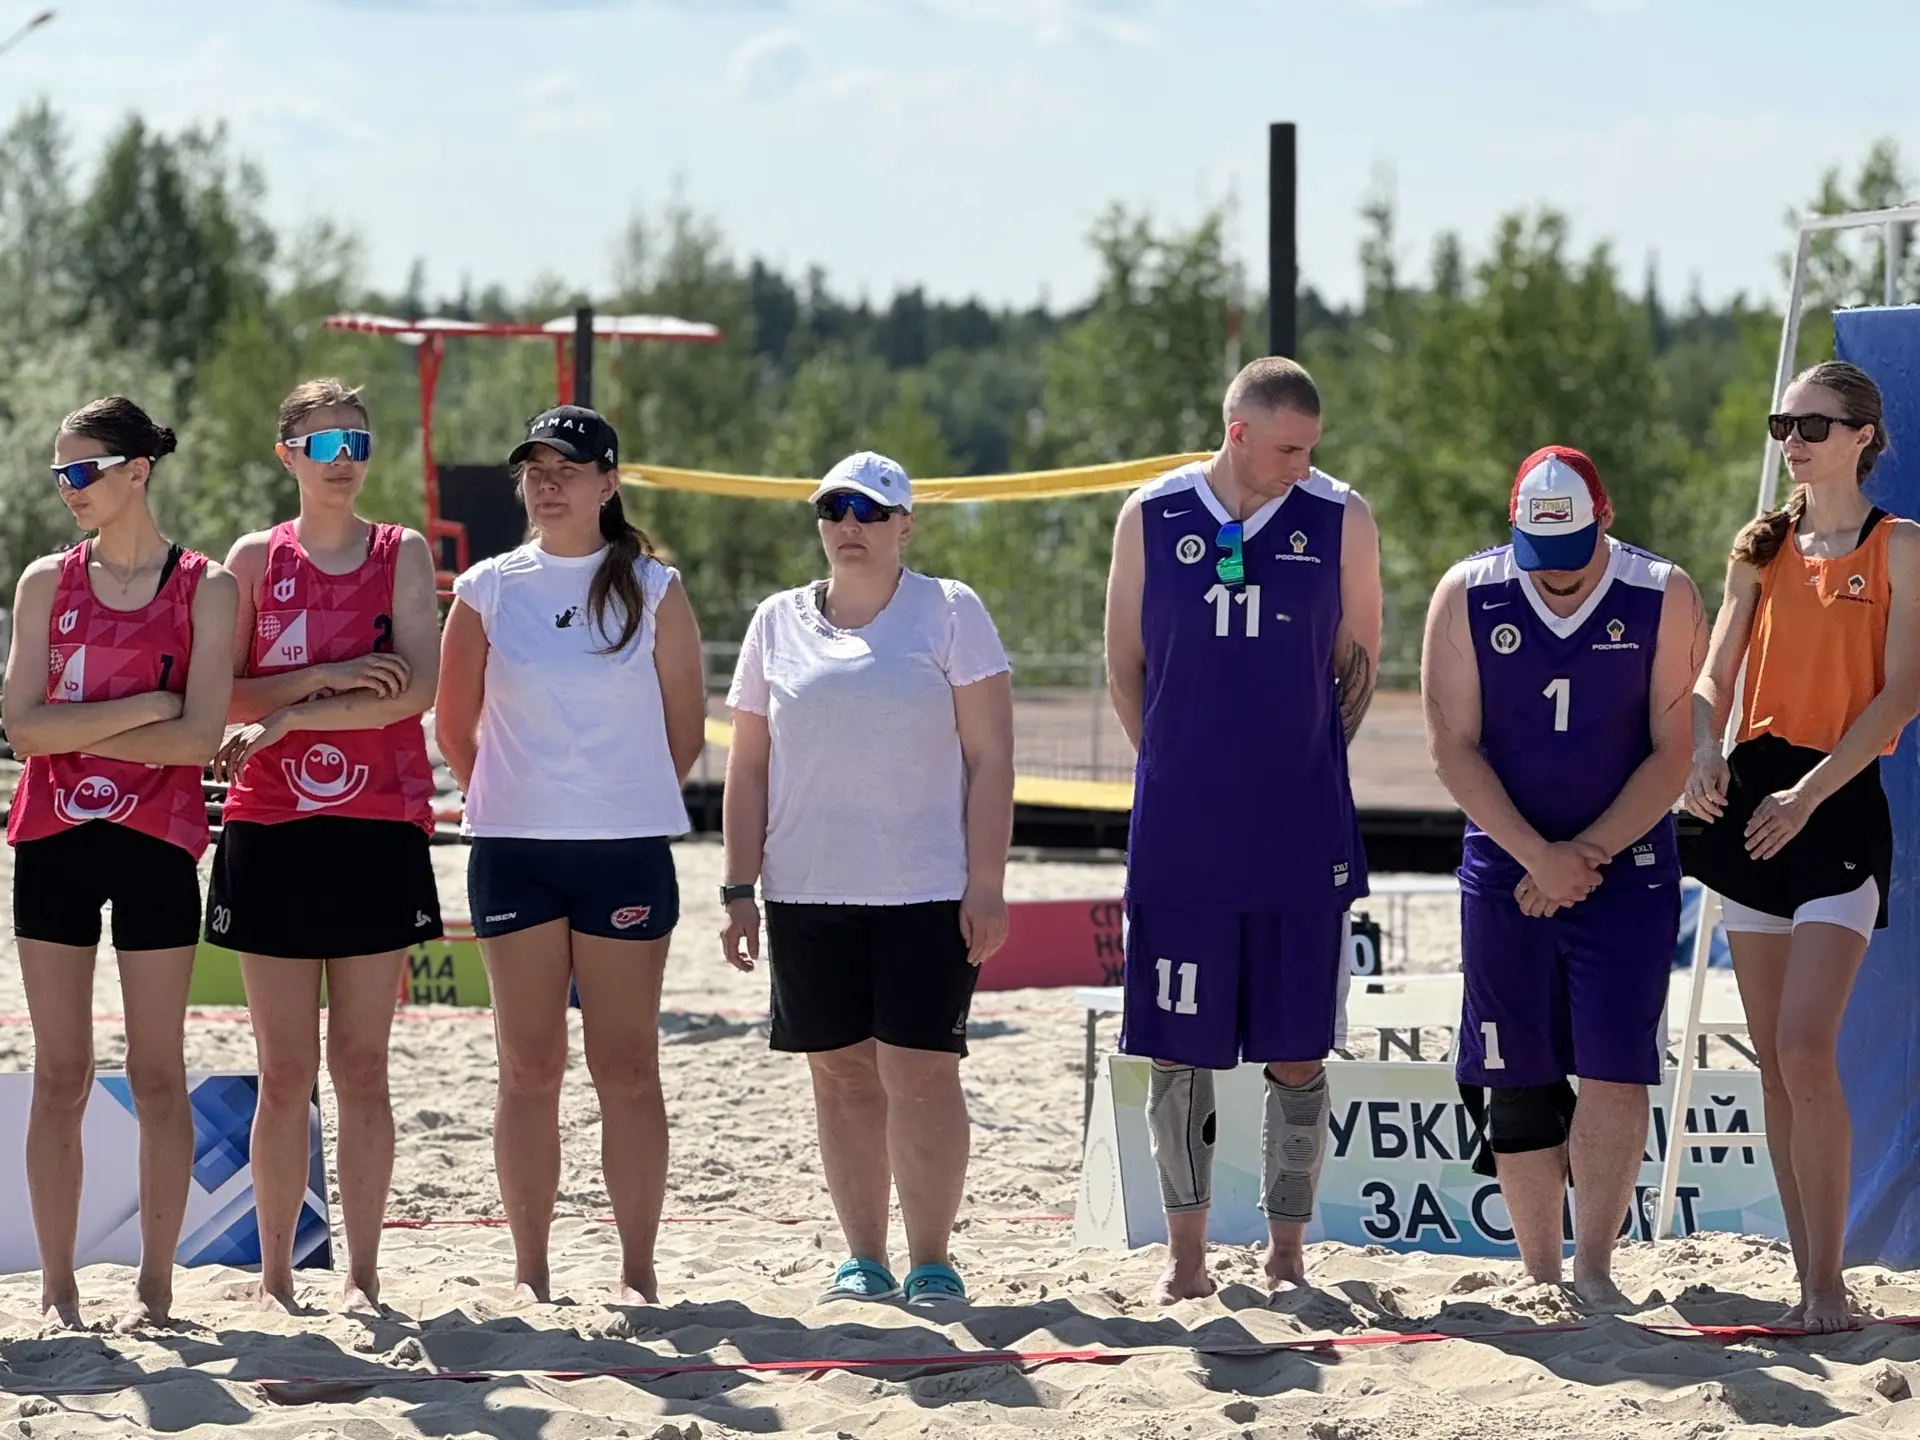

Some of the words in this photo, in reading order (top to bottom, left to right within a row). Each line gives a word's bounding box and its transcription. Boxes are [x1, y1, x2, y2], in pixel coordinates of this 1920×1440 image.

[1203, 584, 1261, 638] 11
[158, 654, 175, 691] 1
[281, 645, 304, 661] ЧР
[1542, 679, 1570, 732] 1
[212, 904, 231, 934] 20
[1155, 957, 1198, 1015] 11
[1480, 1021, 1506, 1070] 1
[1361, 1181, 1458, 1239] ЗА
